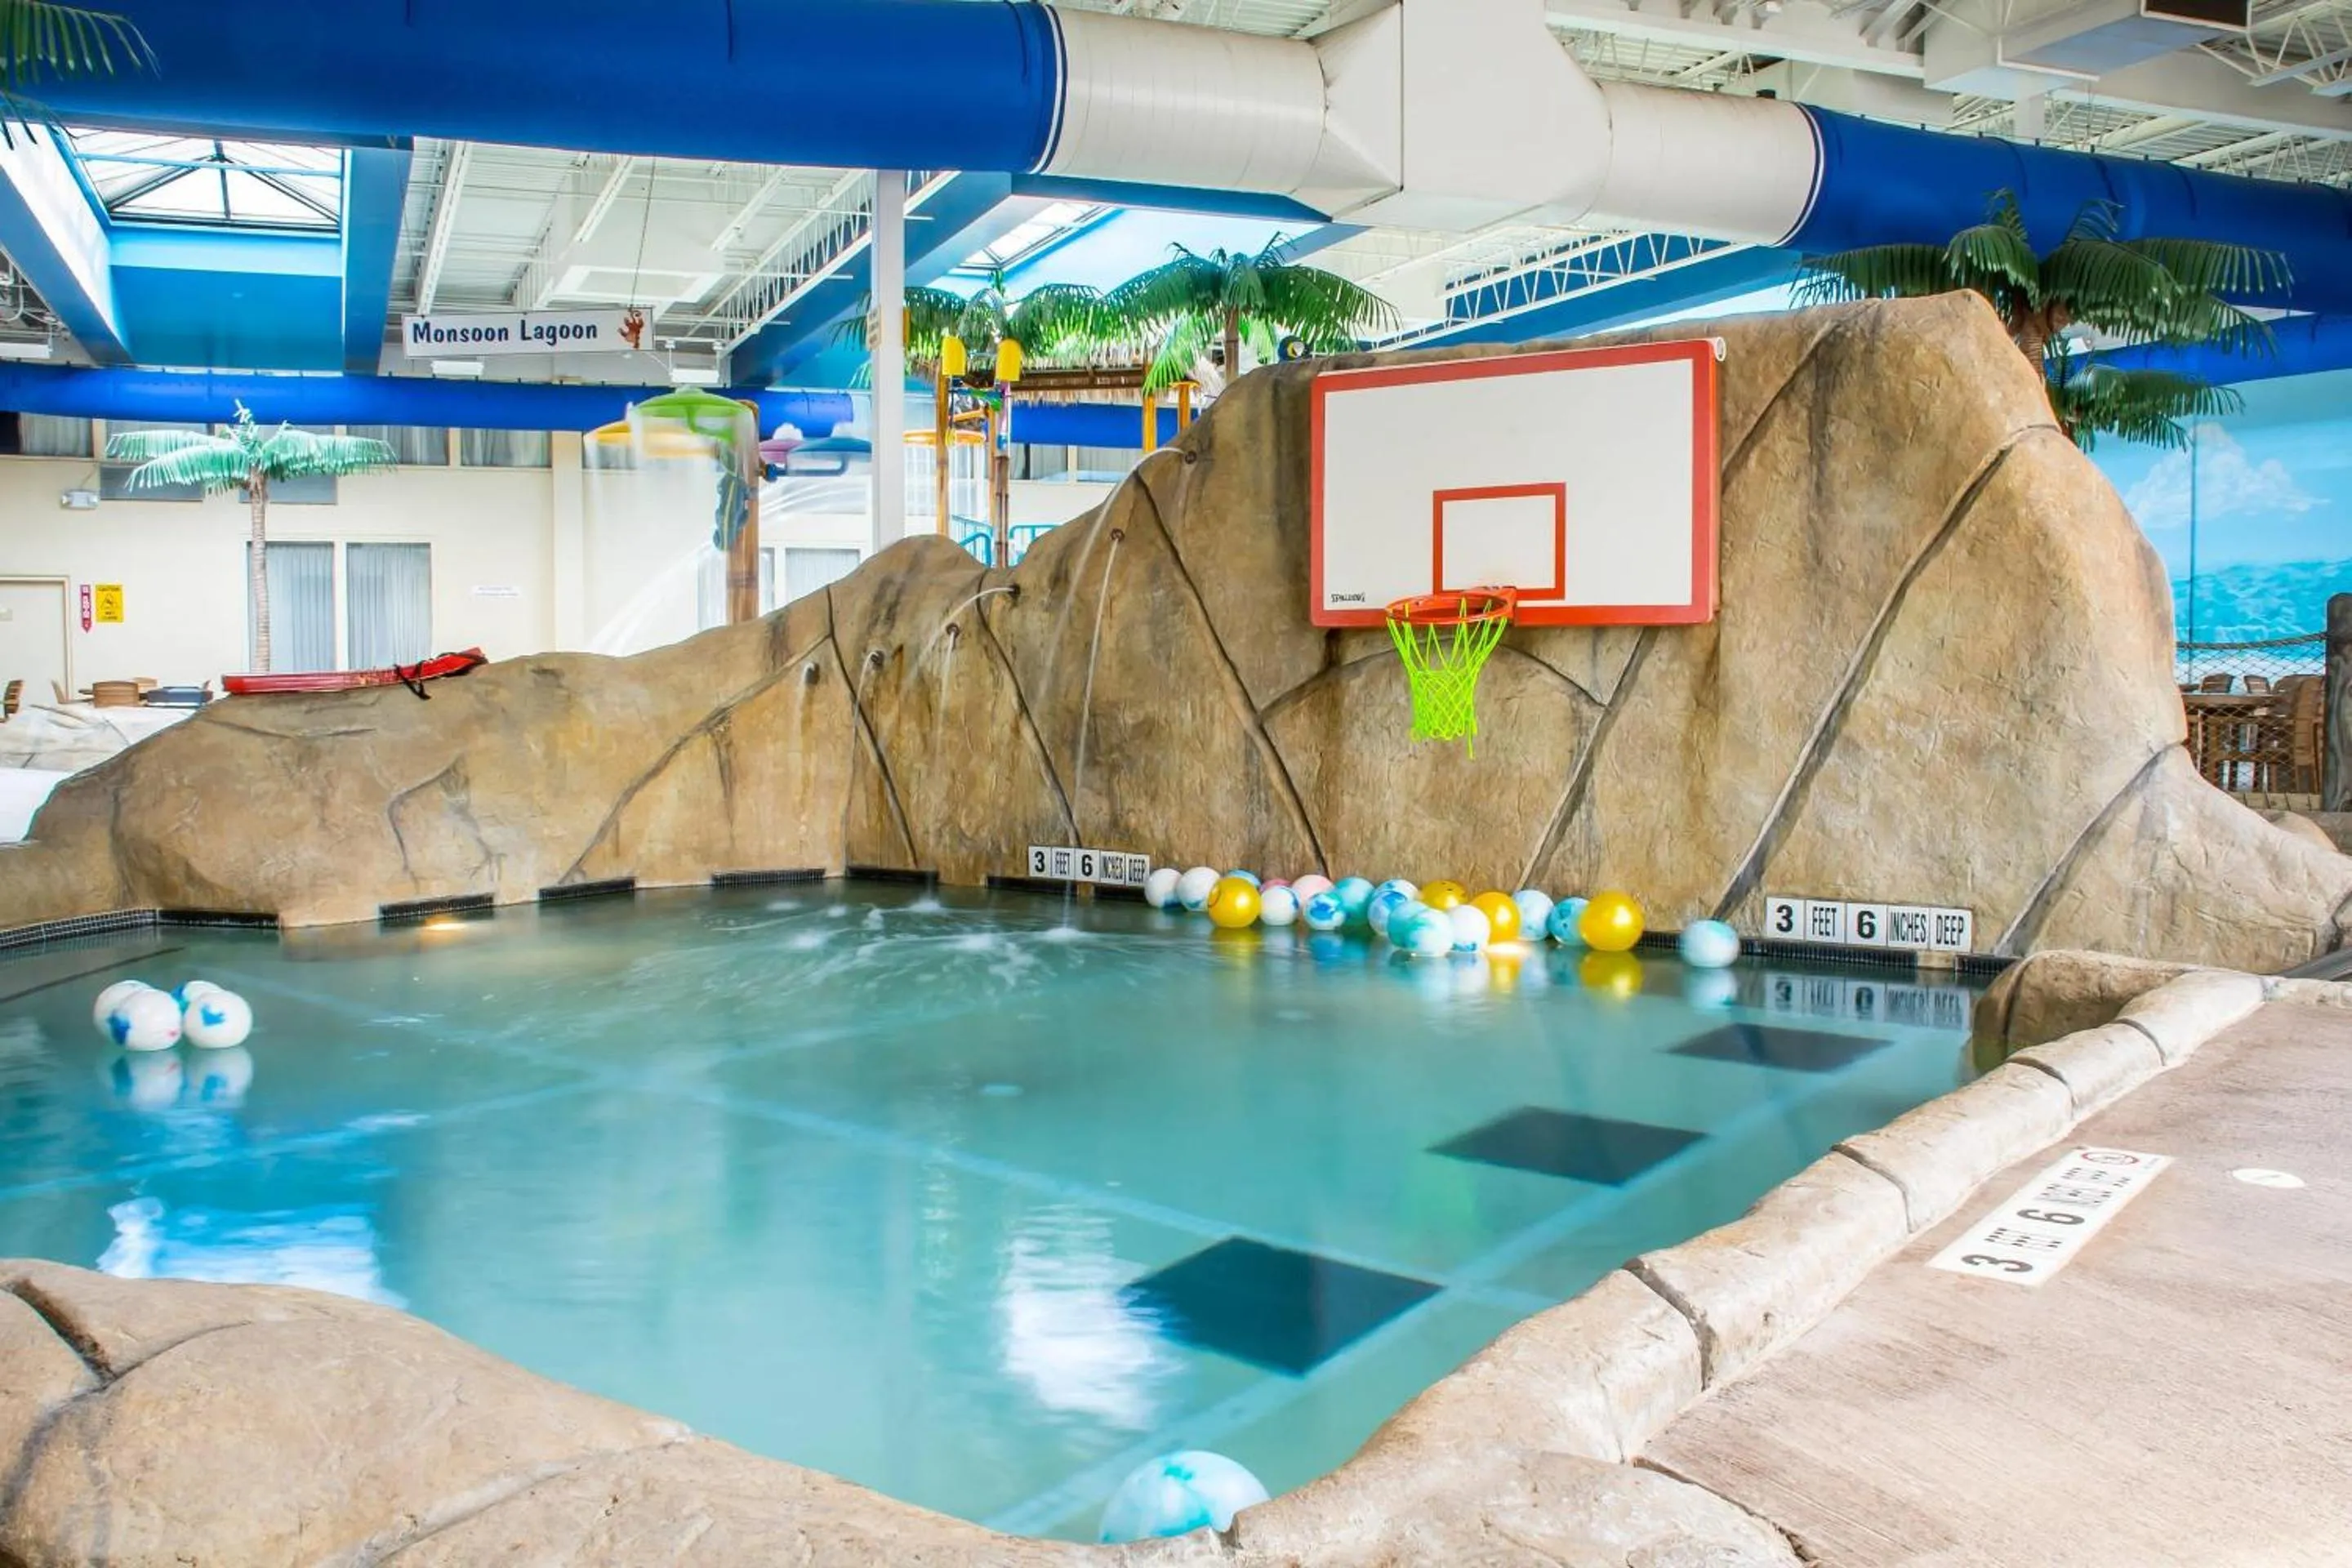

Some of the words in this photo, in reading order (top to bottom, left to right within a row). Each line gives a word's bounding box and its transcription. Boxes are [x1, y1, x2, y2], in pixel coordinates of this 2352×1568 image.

[412, 321, 509, 343] Monsoon
[520, 319, 598, 346] Lagoon
[1034, 851, 1045, 873] 3
[1054, 852, 1071, 875] FEET
[1081, 854, 1093, 876] 6
[1129, 858, 1146, 882] DEEP
[1775, 904, 1793, 933] 3
[1811, 906, 1838, 937] FEET
[1857, 911, 1876, 939] 6
[1890, 911, 1927, 942] INCHES
[1936, 914, 1964, 946] DEEP
[1961, 1254, 2034, 1273] 3
[2016, 1209, 2085, 1226] 6
